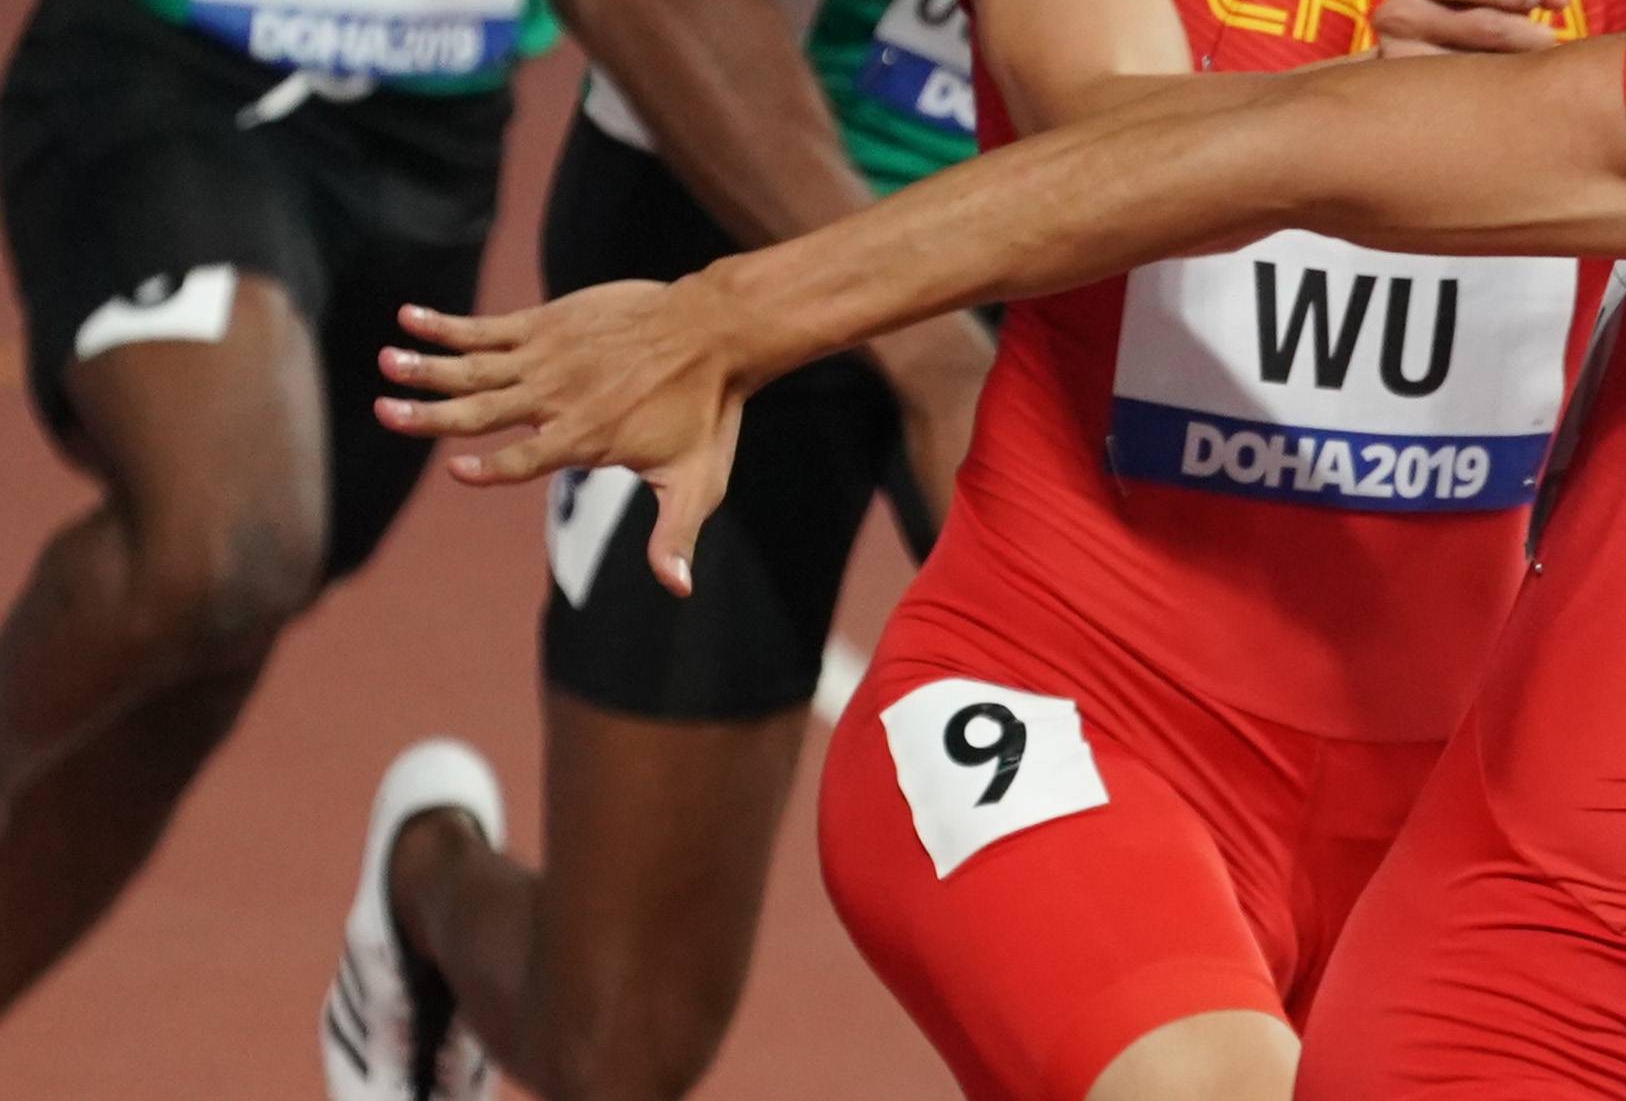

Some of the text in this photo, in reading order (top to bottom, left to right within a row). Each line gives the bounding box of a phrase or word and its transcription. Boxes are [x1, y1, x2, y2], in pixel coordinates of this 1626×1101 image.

[250, 10, 482, 73] DOHA2019
[1254, 260, 1458, 398] WU
[1181, 421, 1490, 500] DOHA2019
[943, 702, 1027, 808] 9
